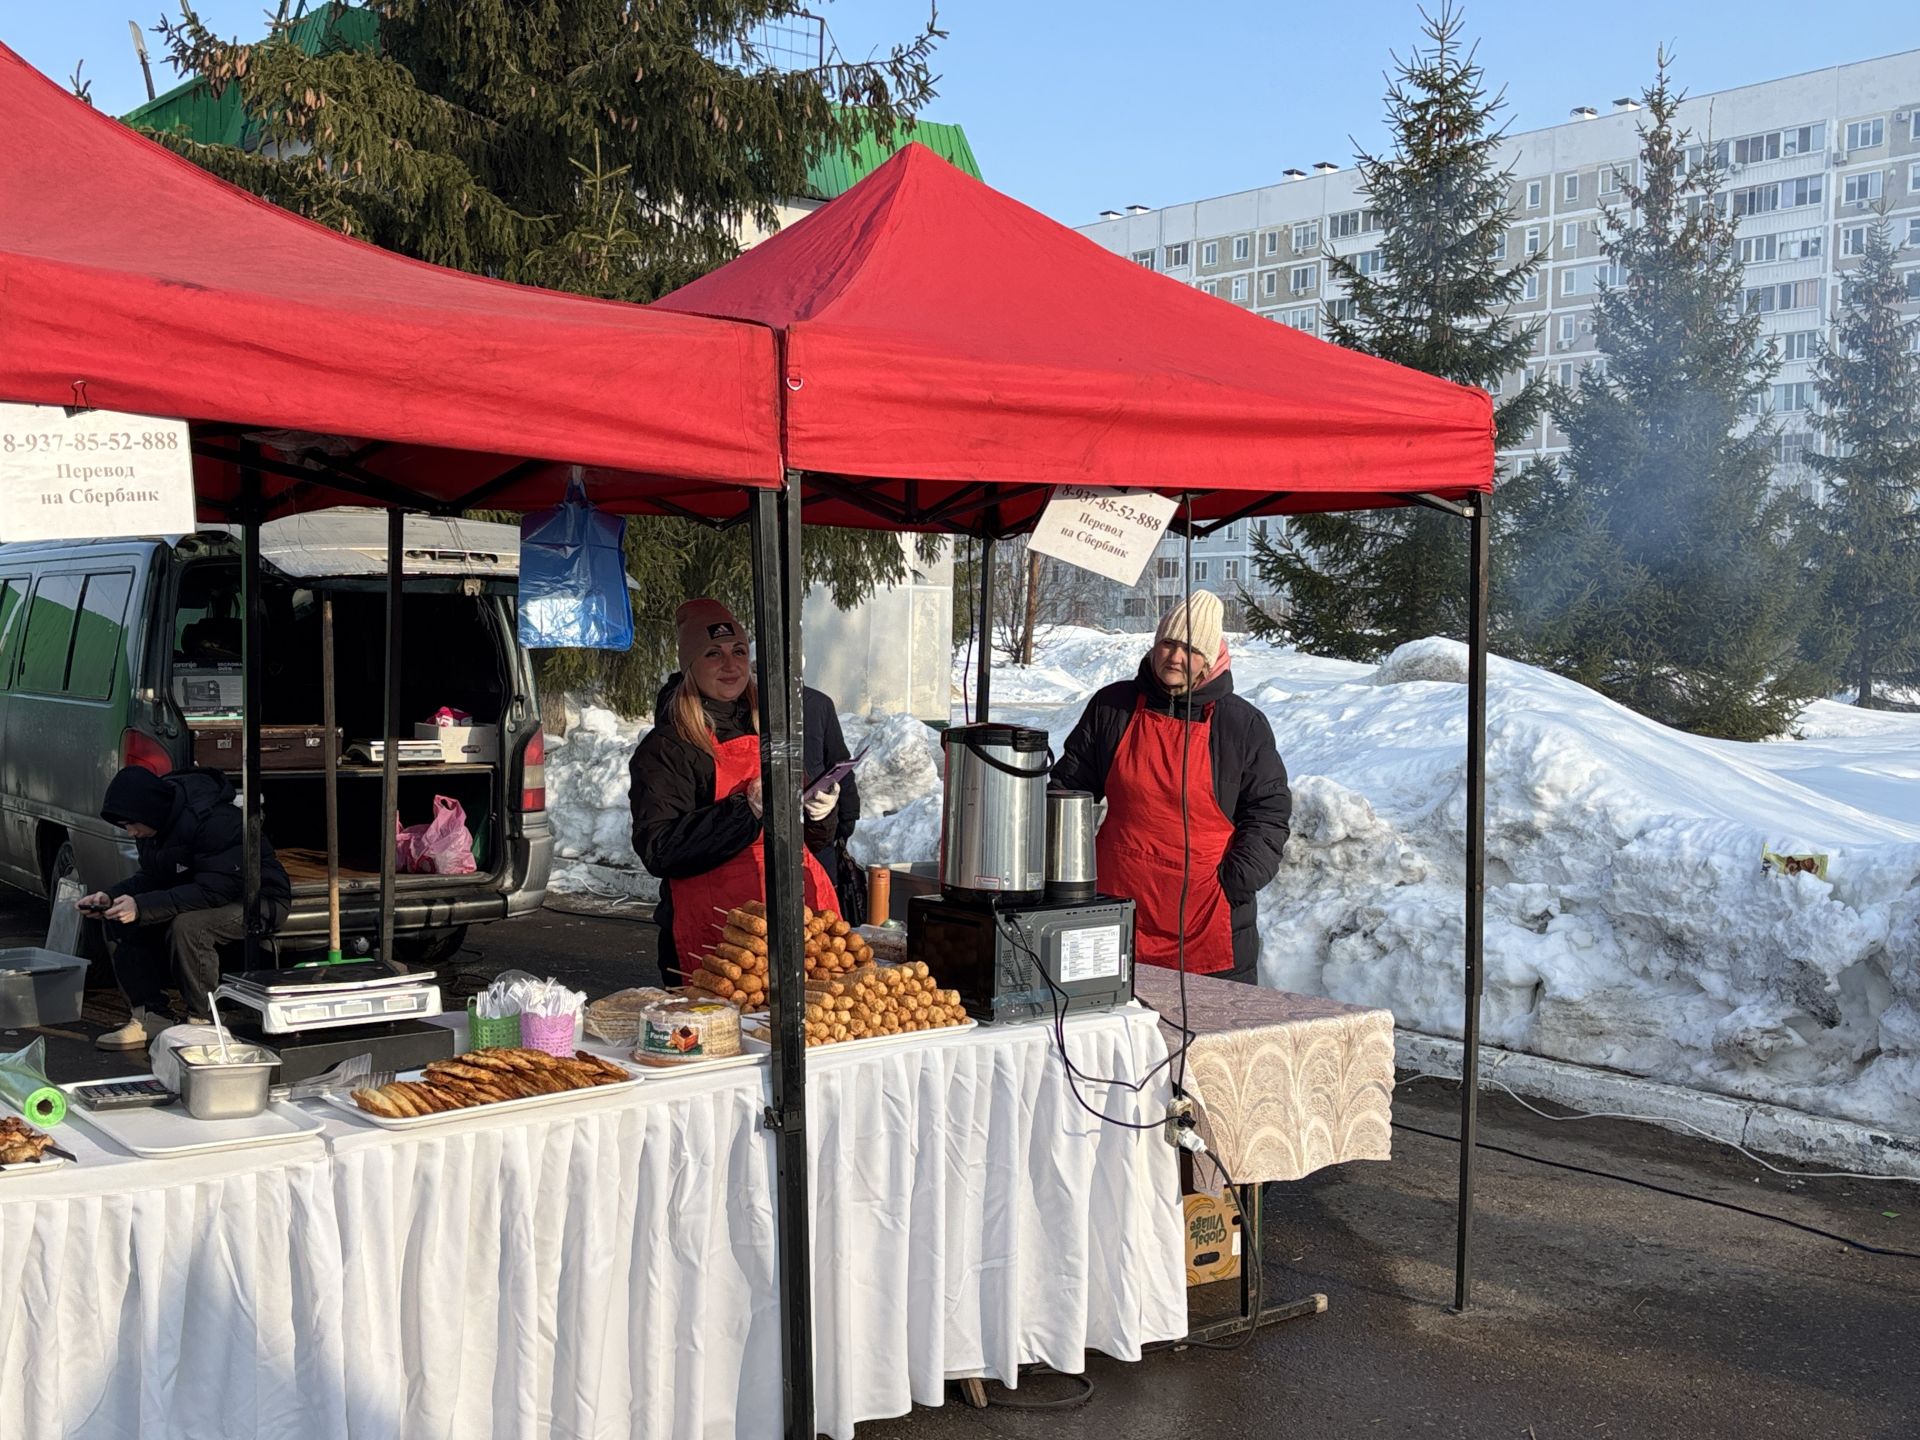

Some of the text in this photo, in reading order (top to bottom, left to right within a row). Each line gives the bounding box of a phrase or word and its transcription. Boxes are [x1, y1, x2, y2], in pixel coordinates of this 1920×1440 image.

[2, 431, 179, 453] 8-937-85-52-888
[56, 463, 136, 482] Перевод
[41, 487, 160, 507] на Сбербанк
[1062, 484, 1162, 532] 8-937-85-52-888
[1079, 512, 1125, 538] Перевод
[1060, 526, 1129, 558] на Сбербанк
[1190, 1214, 1225, 1232] Village
[1192, 1229, 1227, 1249] Global
